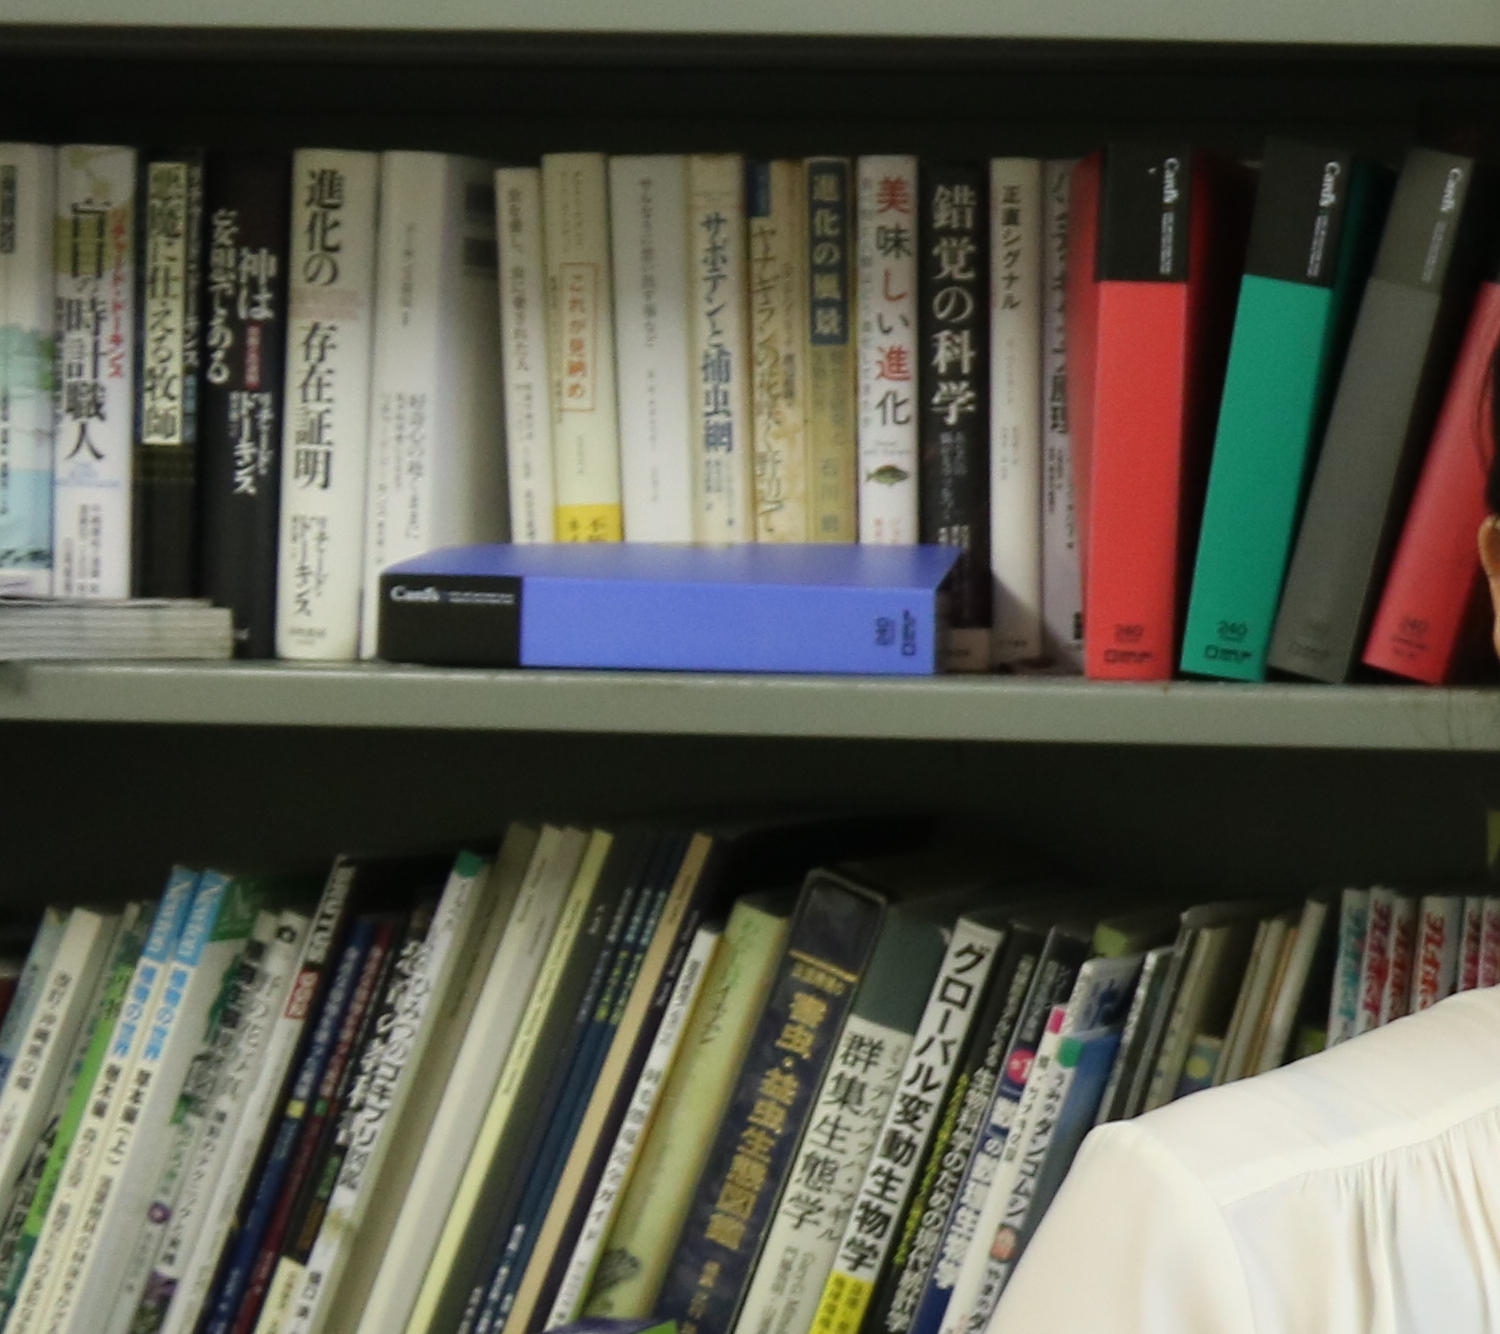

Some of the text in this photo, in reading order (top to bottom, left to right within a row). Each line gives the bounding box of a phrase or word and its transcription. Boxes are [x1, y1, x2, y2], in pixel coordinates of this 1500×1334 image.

[238, 246, 277, 322] 神は
[874, 174, 913, 430] 美味しい進化
[930, 183, 977, 428] 錯覚の科学
[999, 185, 1022, 312] 正直シグナル
[782, 1033, 884, 1231] 群集生態学
[841, 941, 990, 1272] グローバル変動生物学
